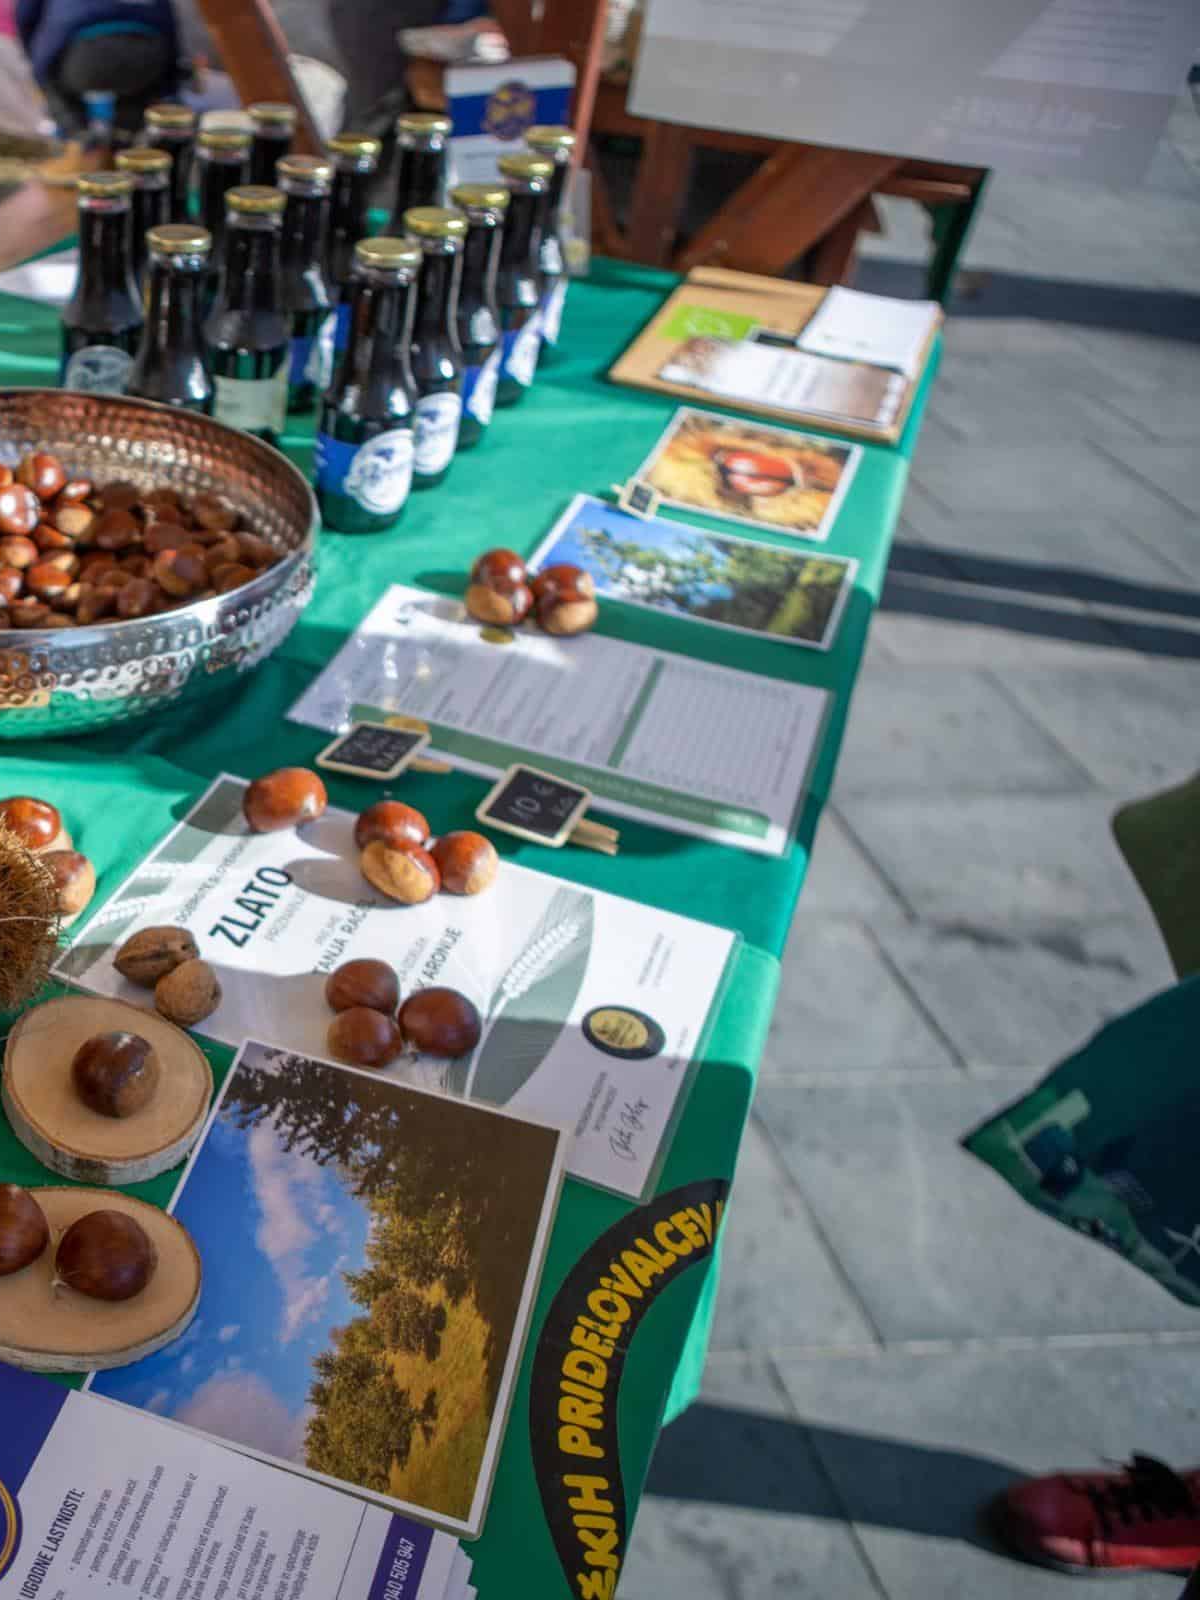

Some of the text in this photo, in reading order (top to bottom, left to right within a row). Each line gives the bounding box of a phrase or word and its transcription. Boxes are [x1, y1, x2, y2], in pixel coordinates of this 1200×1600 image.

[208, 866, 294, 948] ZLATO
[312, 937, 349, 975] TANJA
[557, 1202, 712, 1459] PRIDELOVALCEV
[397, 1537, 417, 1560] 947
[389, 1557, 410, 1582] 505
